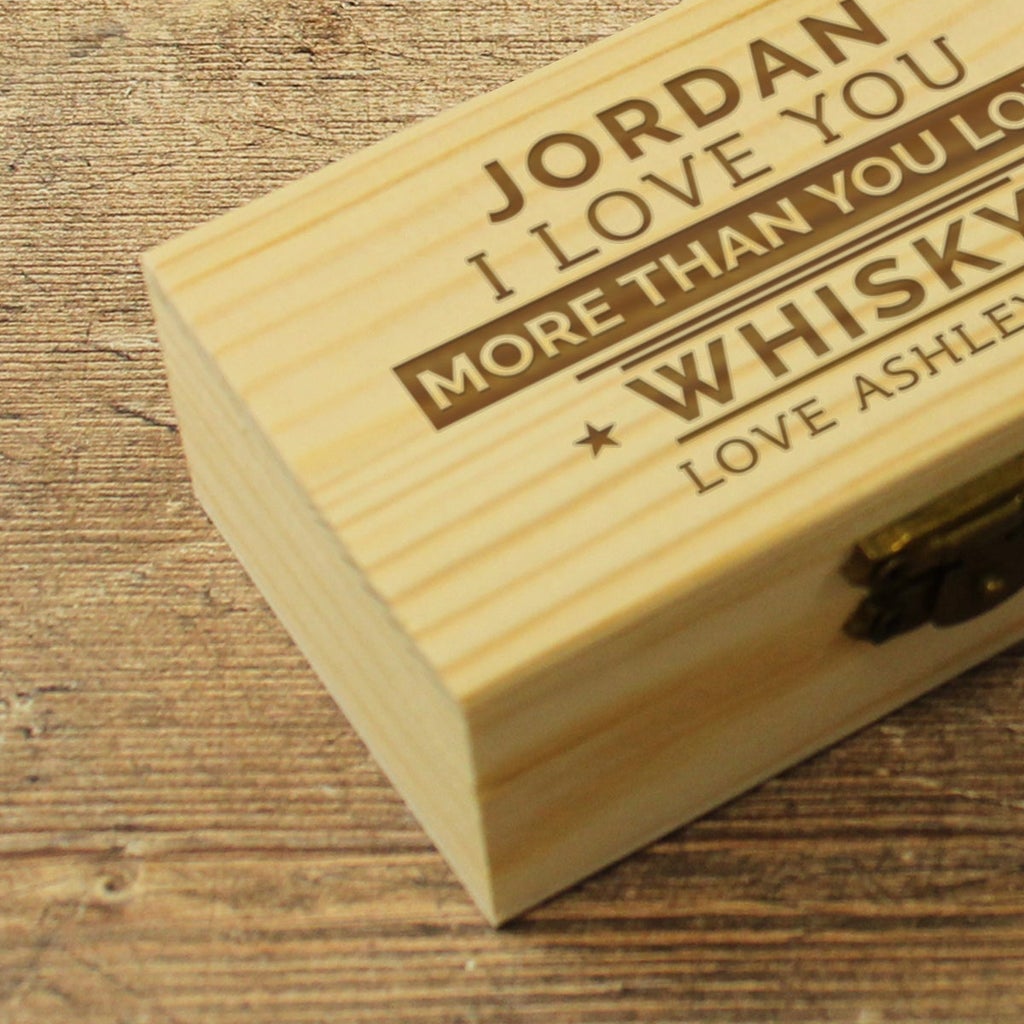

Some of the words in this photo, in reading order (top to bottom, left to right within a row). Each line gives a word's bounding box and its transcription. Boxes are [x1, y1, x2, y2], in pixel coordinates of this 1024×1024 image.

[414, 287, 628, 411] MORE
[617, 196, 810, 307] THAN
[805, 130, 948, 216] YOU
[466, 251, 515, 302] I
[530, 132, 772, 271] LOVE
[780, 35, 966, 146] YOU
[678, 396, 838, 494] LOVE
